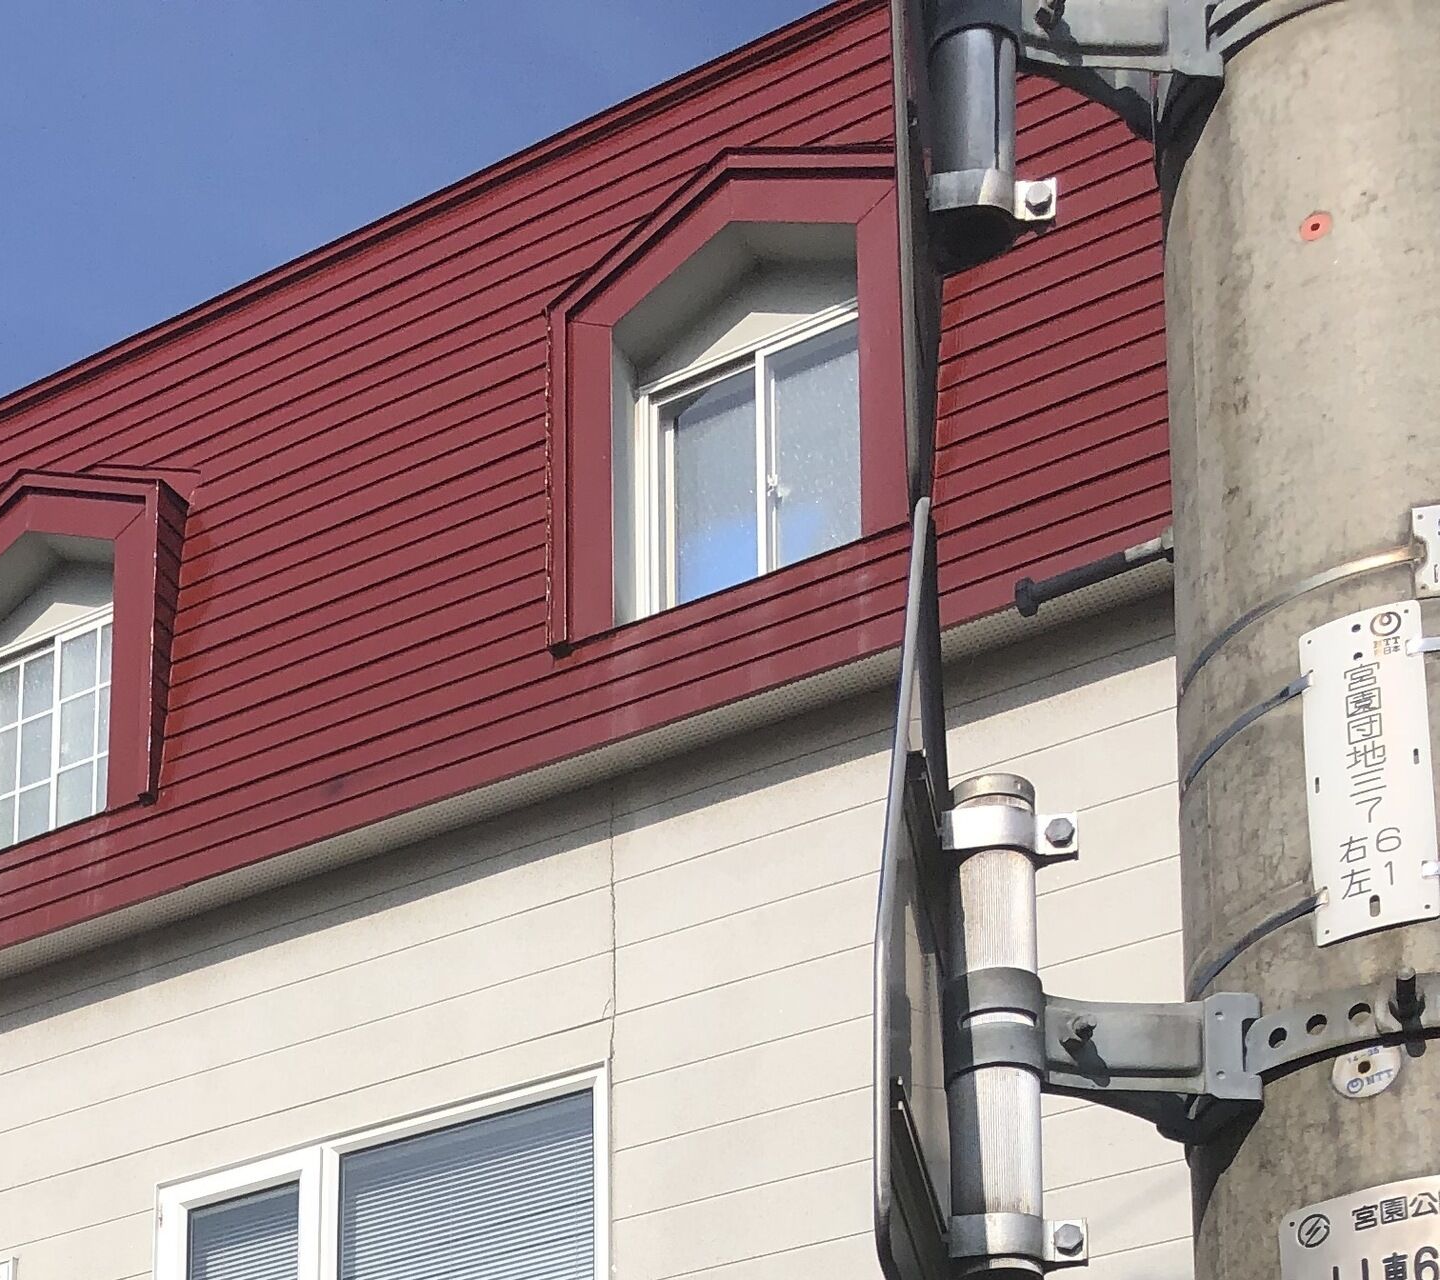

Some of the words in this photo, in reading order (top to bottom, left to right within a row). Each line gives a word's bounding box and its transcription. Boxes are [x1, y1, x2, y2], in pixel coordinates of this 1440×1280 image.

[1365, 1068, 1394, 1086] NTT
[1352, 1191, 1440, 1231] 宮園公
